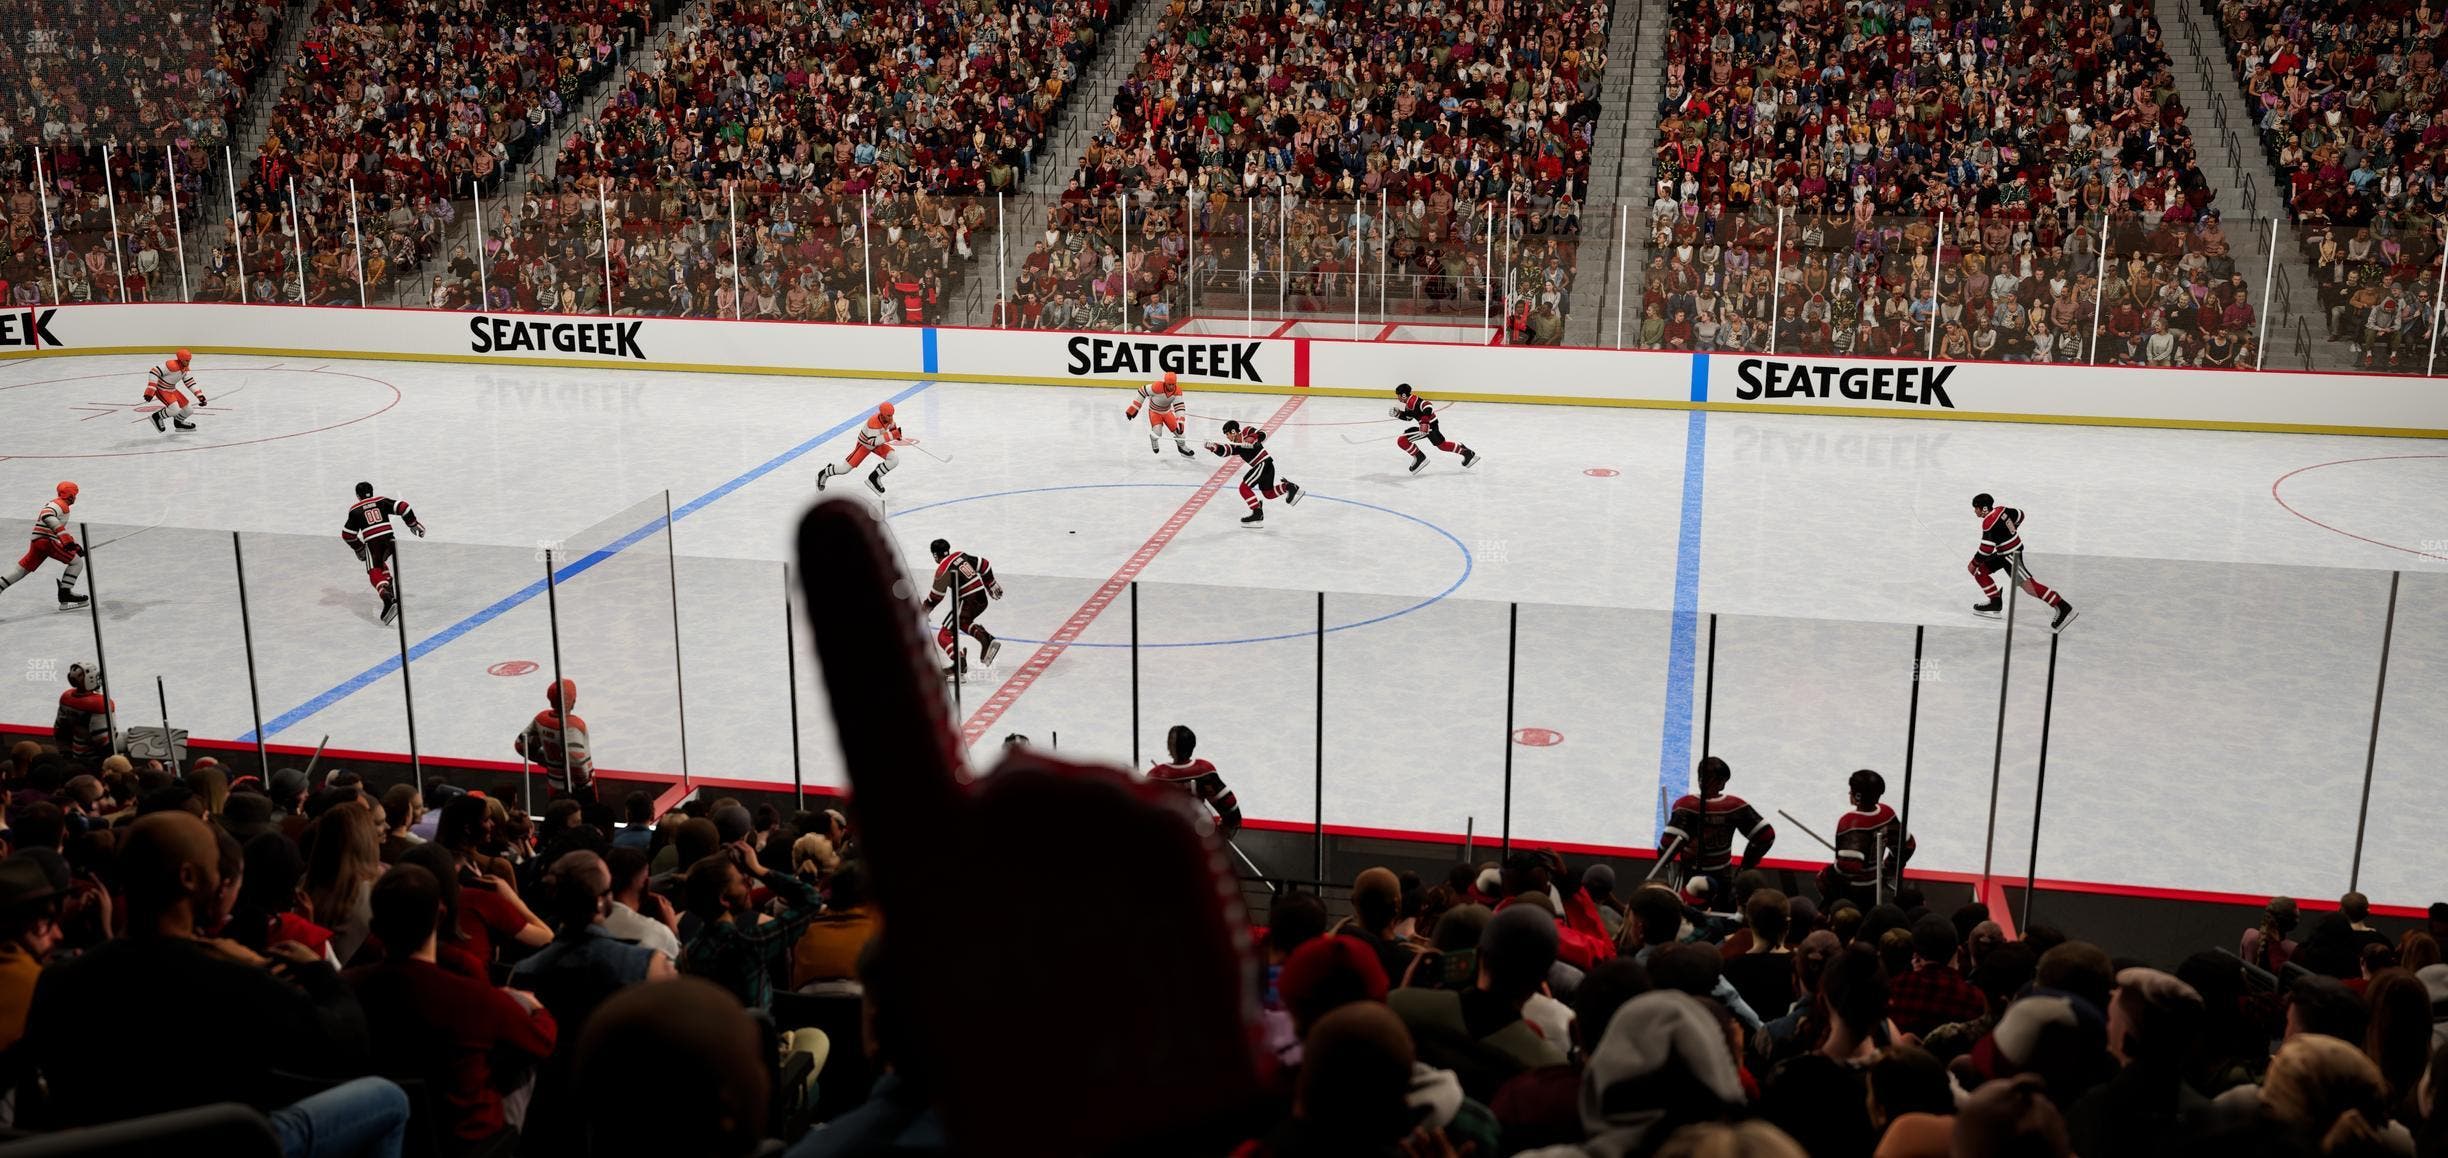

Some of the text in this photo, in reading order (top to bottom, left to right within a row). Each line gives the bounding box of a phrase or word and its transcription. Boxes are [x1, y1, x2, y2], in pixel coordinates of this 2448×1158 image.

[470, 315, 647, 360] SEATGEEK
[1067, 336, 1263, 383] SEATGEEK
[1736, 358, 1958, 409] SEATGEEK
